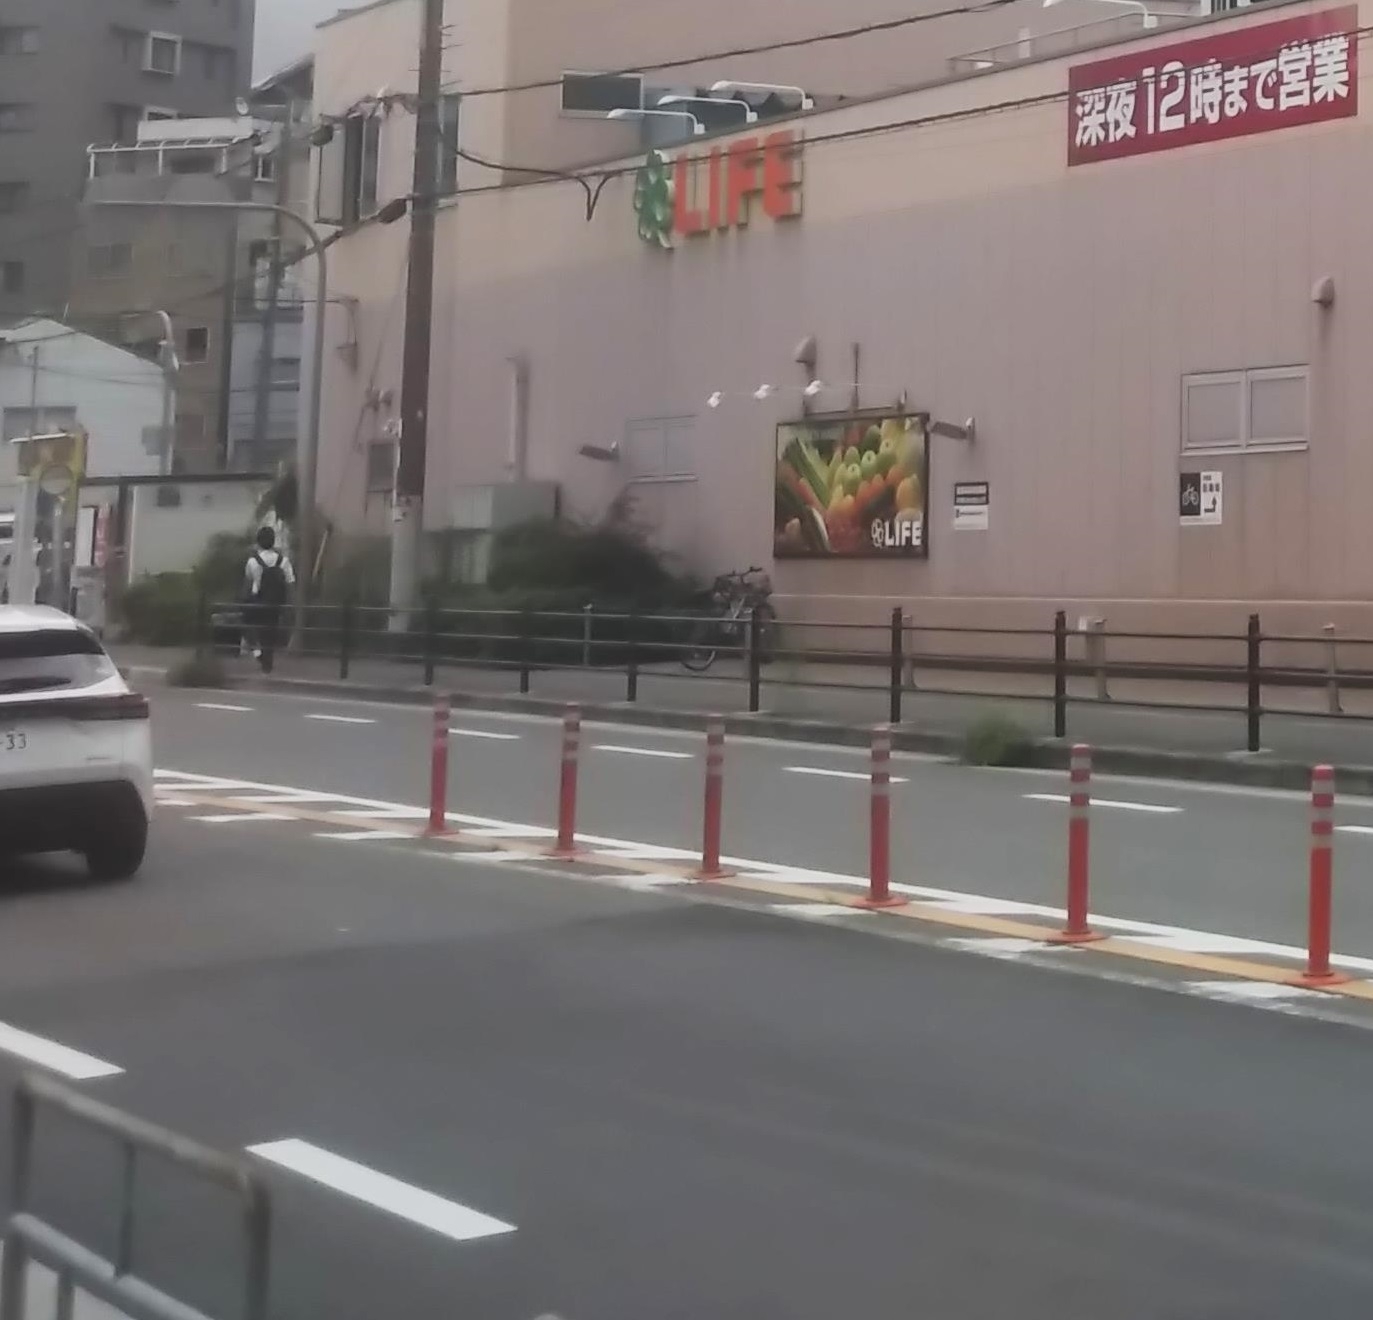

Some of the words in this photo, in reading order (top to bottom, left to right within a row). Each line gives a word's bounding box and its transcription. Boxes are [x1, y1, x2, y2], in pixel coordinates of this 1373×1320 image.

[1075, 31, 1350, 148] 深夜12時まで営業
[674, 130, 802, 237] LIFE
[884, 520, 922, 547] LIFE
